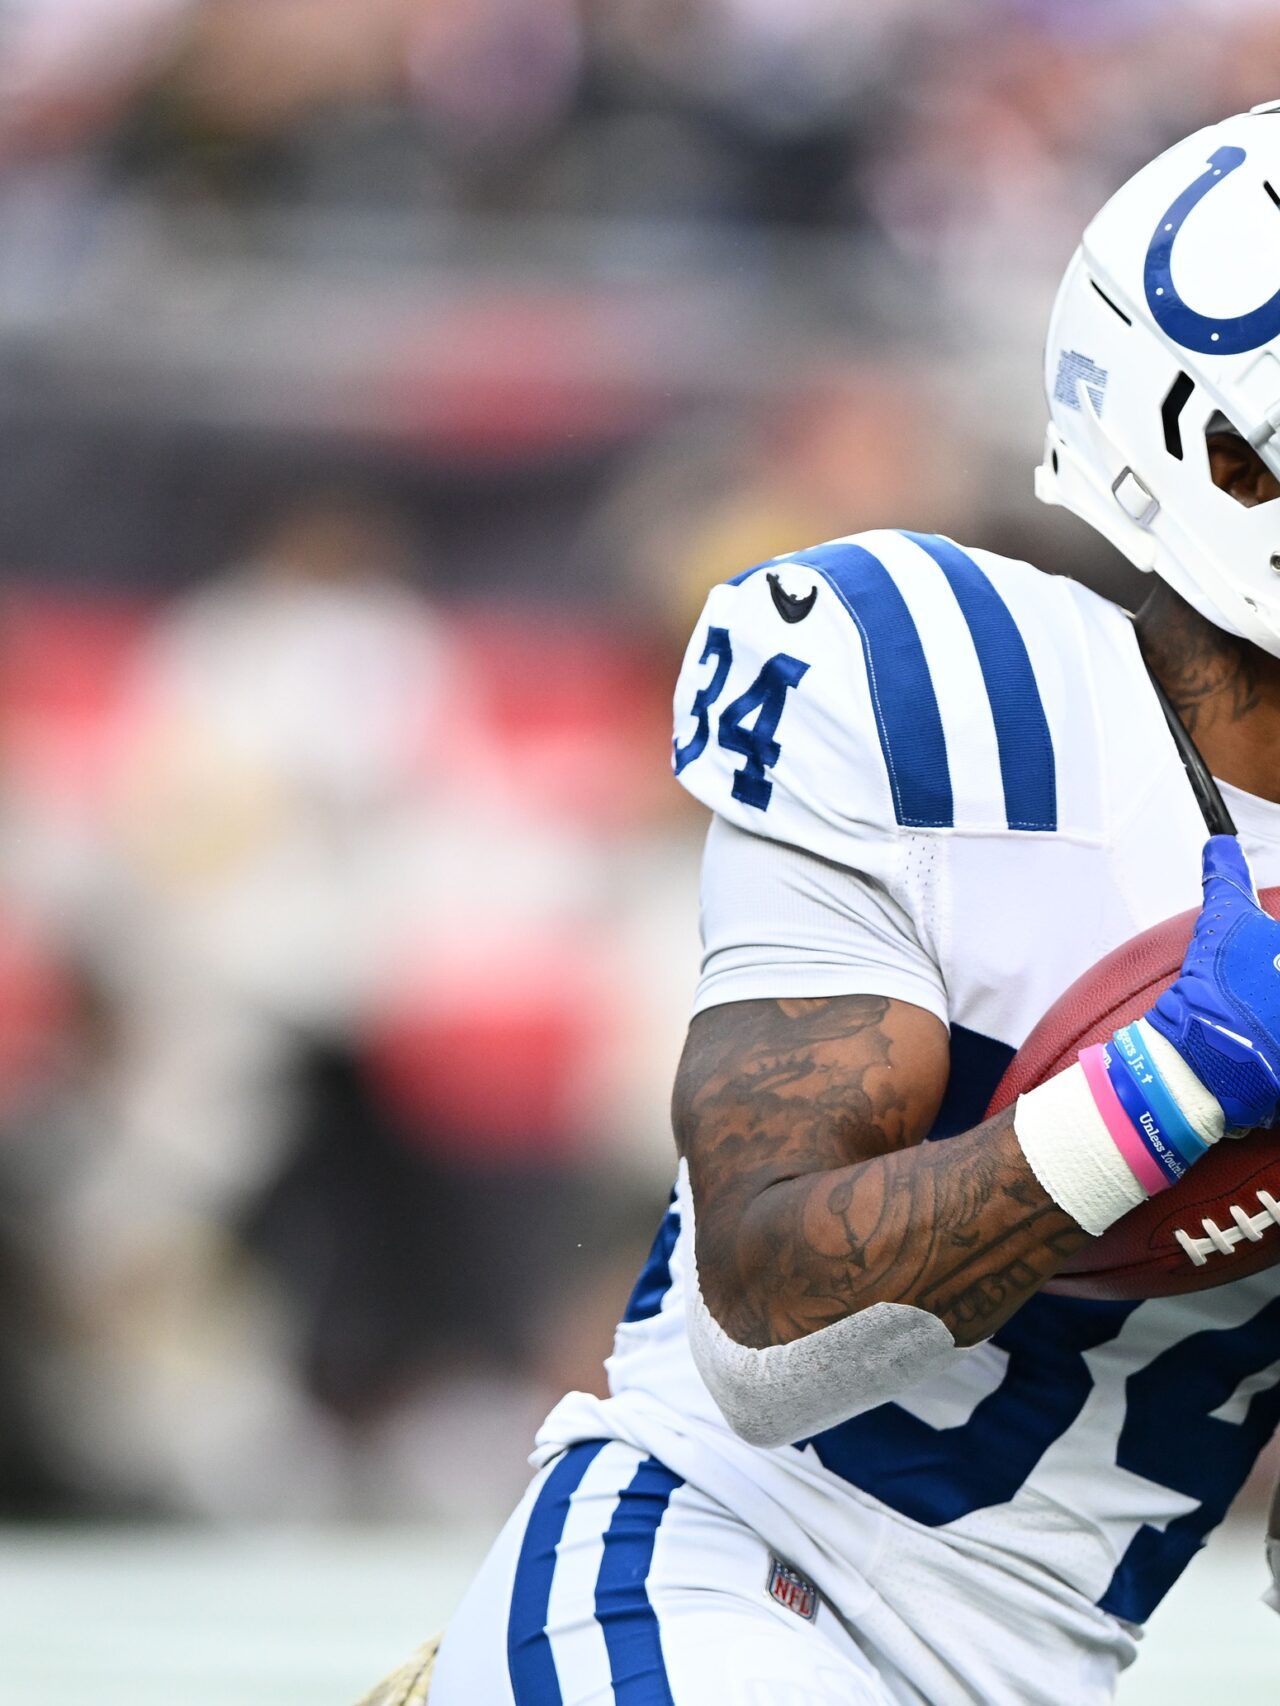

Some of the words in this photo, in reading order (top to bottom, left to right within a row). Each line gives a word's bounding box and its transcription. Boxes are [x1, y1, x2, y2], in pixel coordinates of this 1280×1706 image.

[672, 625, 811, 812] 34
[1139, 1111, 1166, 1153] Unless
[773, 1575, 811, 1616] NFL
